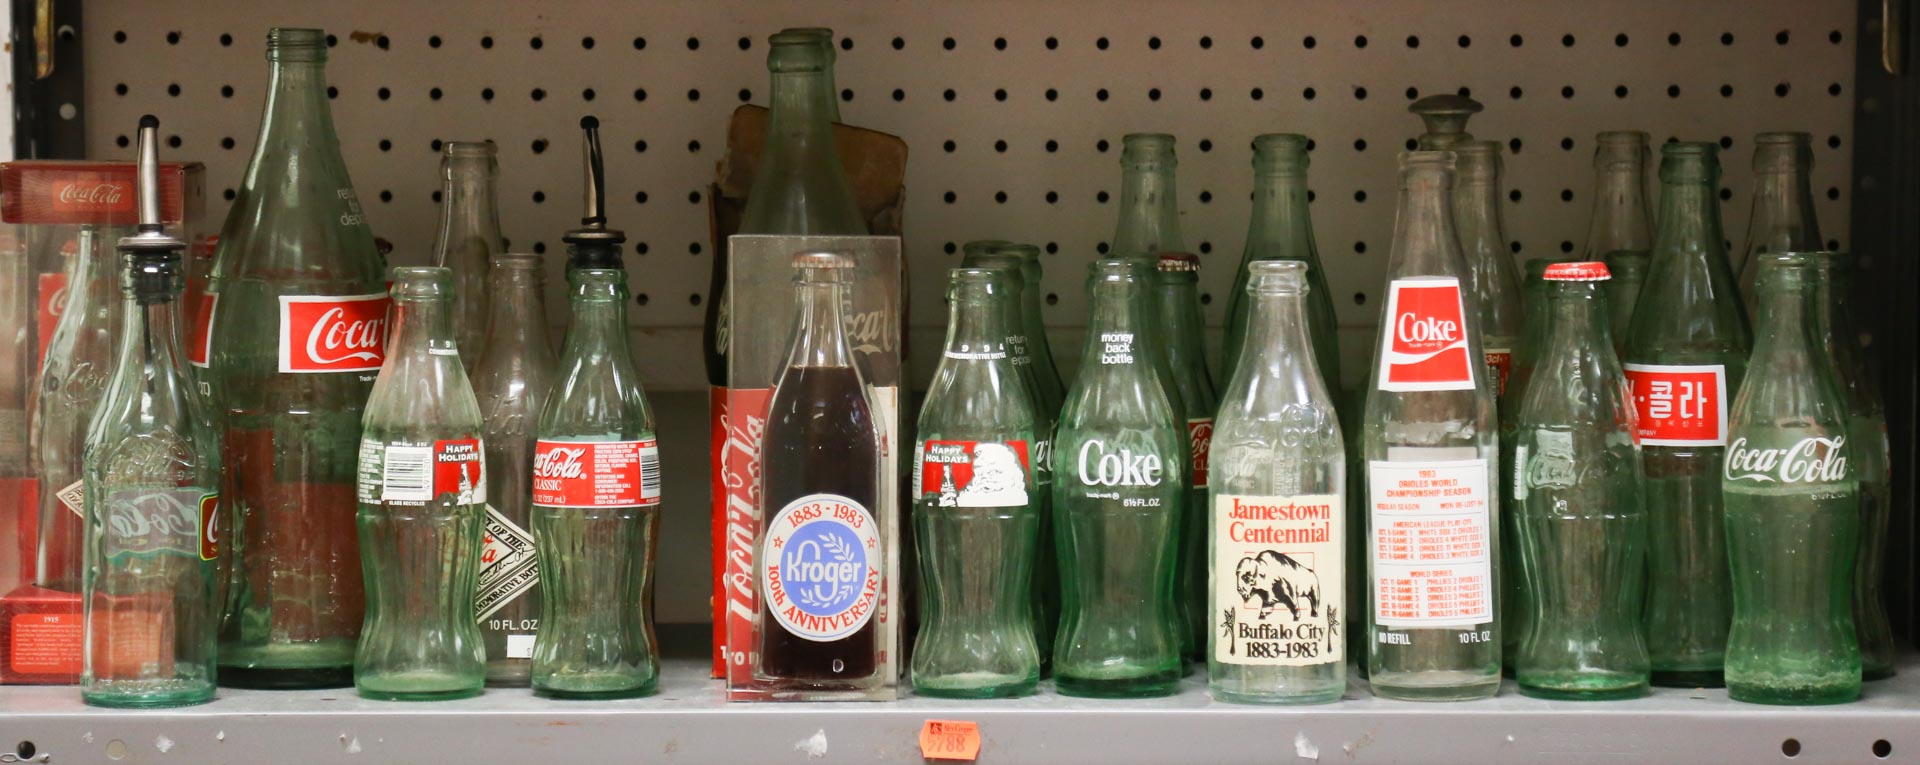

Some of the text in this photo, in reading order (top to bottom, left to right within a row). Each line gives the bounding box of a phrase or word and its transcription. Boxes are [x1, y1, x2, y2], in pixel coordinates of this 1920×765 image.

[1398, 312, 1457, 342] Coke
[1102, 332, 1134, 343] money
[1105, 343, 1131, 353] back
[1102, 354, 1133, 364] bottle
[446, 445, 474, 454] HAPPY
[932, 445, 961, 454] HAPPY
[439, 453, 478, 462] HOLIDAYS
[925, 454, 968, 463] HOLIDAYS
[1078, 439, 1161, 487] Coke
[1726, 435, 1847, 482] Coca-Cola
[535, 479, 561, 491] CLASSIC
[1444, 488, 1472, 496] SEASON
[788, 503, 822, 528] 1883
[833, 504, 864, 528] 1983
[1229, 498, 1330, 520] Jamestown
[493, 524, 526, 550] OF THE
[1229, 521, 1330, 543] Centennial
[786, 540, 862, 601] Kroger
[768, 566, 786, 607] 100th
[783, 566, 878, 632] ANNIVERSARY
[489, 620, 500, 630] 10
[1238, 623, 1325, 642] Buffalo City
[1388, 632, 1411, 645] REFILL
[1459, 633, 1469, 644] 10
[1471, 632, 1480, 643] FL
[1482, 631, 1490, 641] OZ
[1246, 641, 1319, 658] 1883-1983
